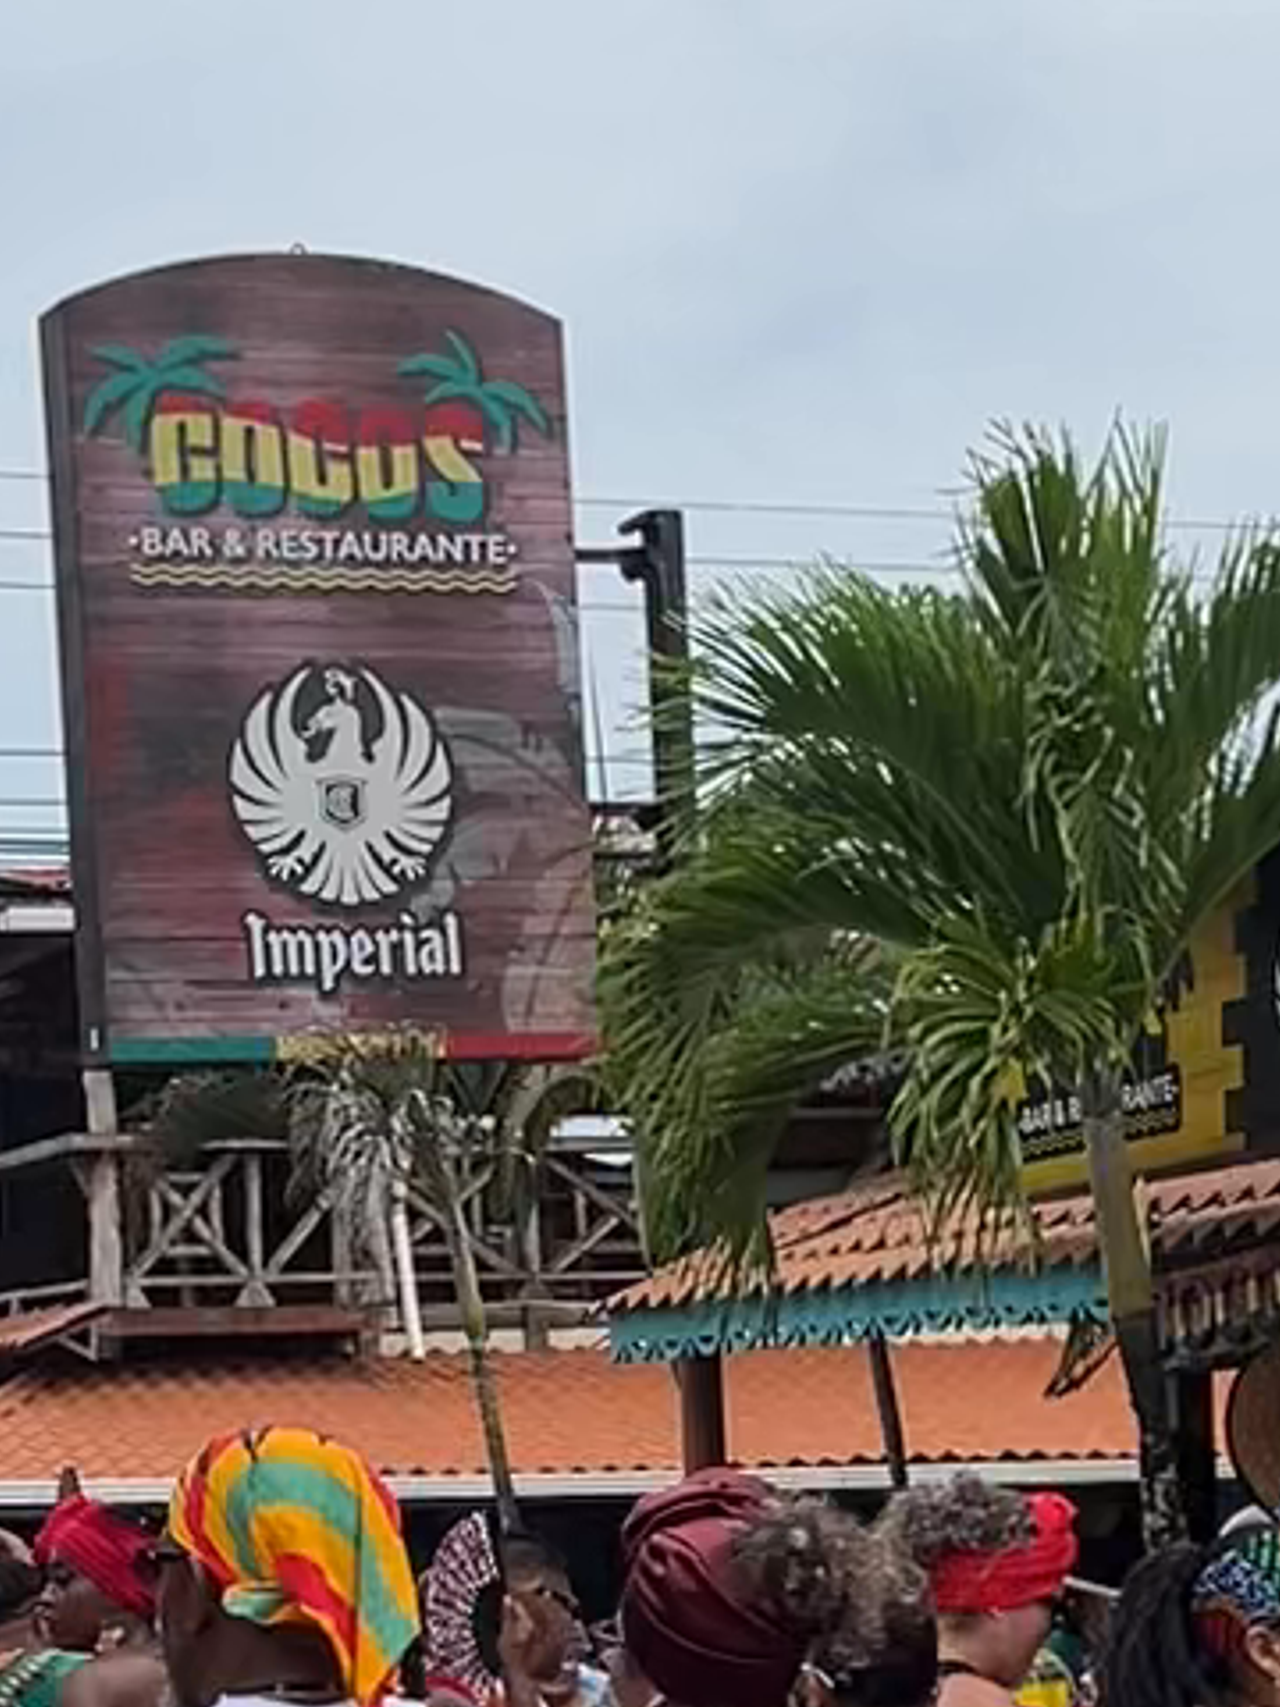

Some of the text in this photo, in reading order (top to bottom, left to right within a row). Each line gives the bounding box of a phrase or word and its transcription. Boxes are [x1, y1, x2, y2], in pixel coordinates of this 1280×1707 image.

[140, 525, 508, 564] BAR & RESTAURANTE
[245, 911, 463, 993] Imperial
